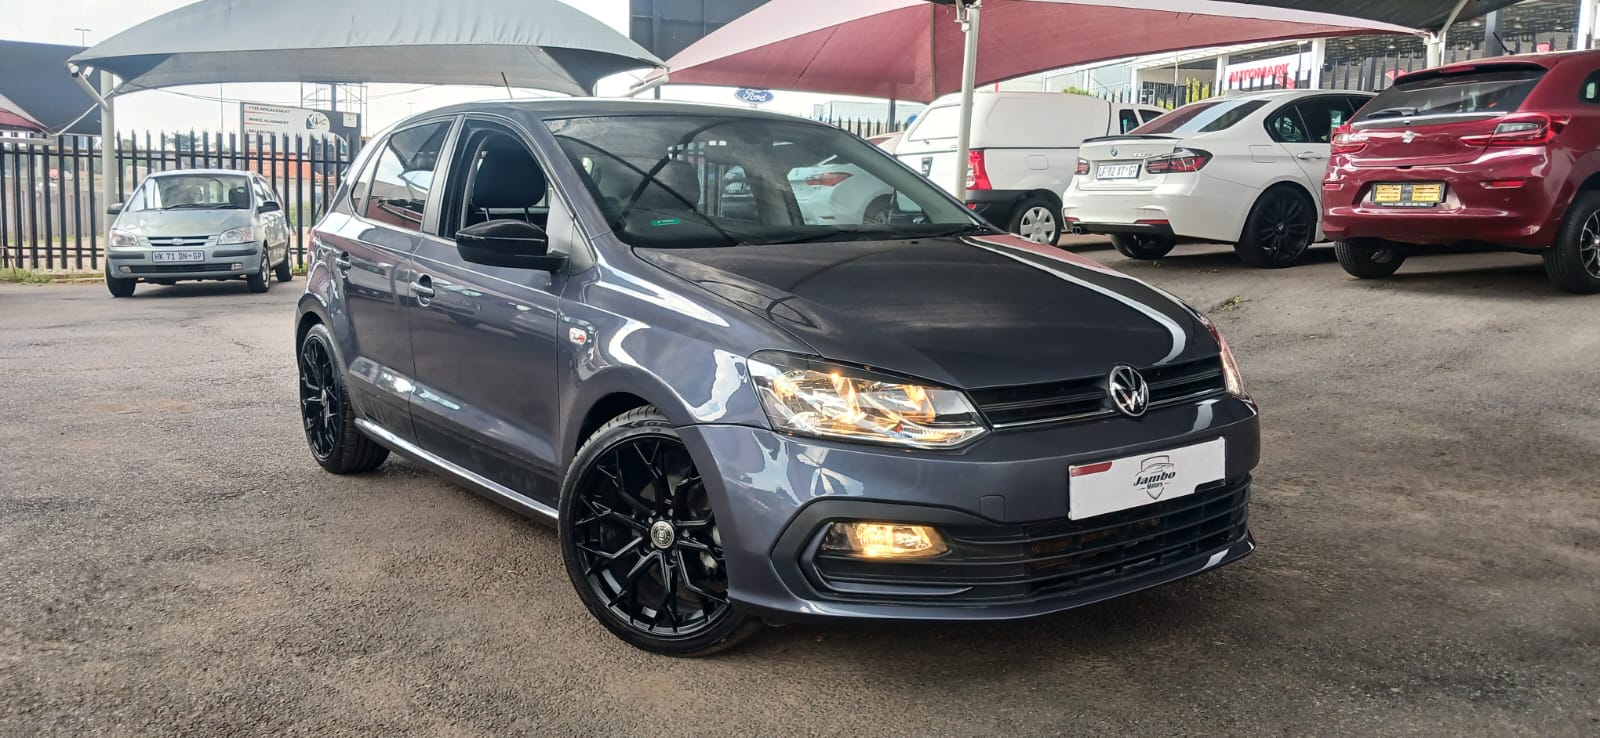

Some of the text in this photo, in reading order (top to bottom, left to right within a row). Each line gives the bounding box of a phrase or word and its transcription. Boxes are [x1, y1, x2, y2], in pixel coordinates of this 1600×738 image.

[1229, 63, 1289, 82] AUTOMARK
[743, 89, 767, 101] Ford
[1133, 471, 1176, 486] Jambo
[1147, 482, 1163, 490] Motors
